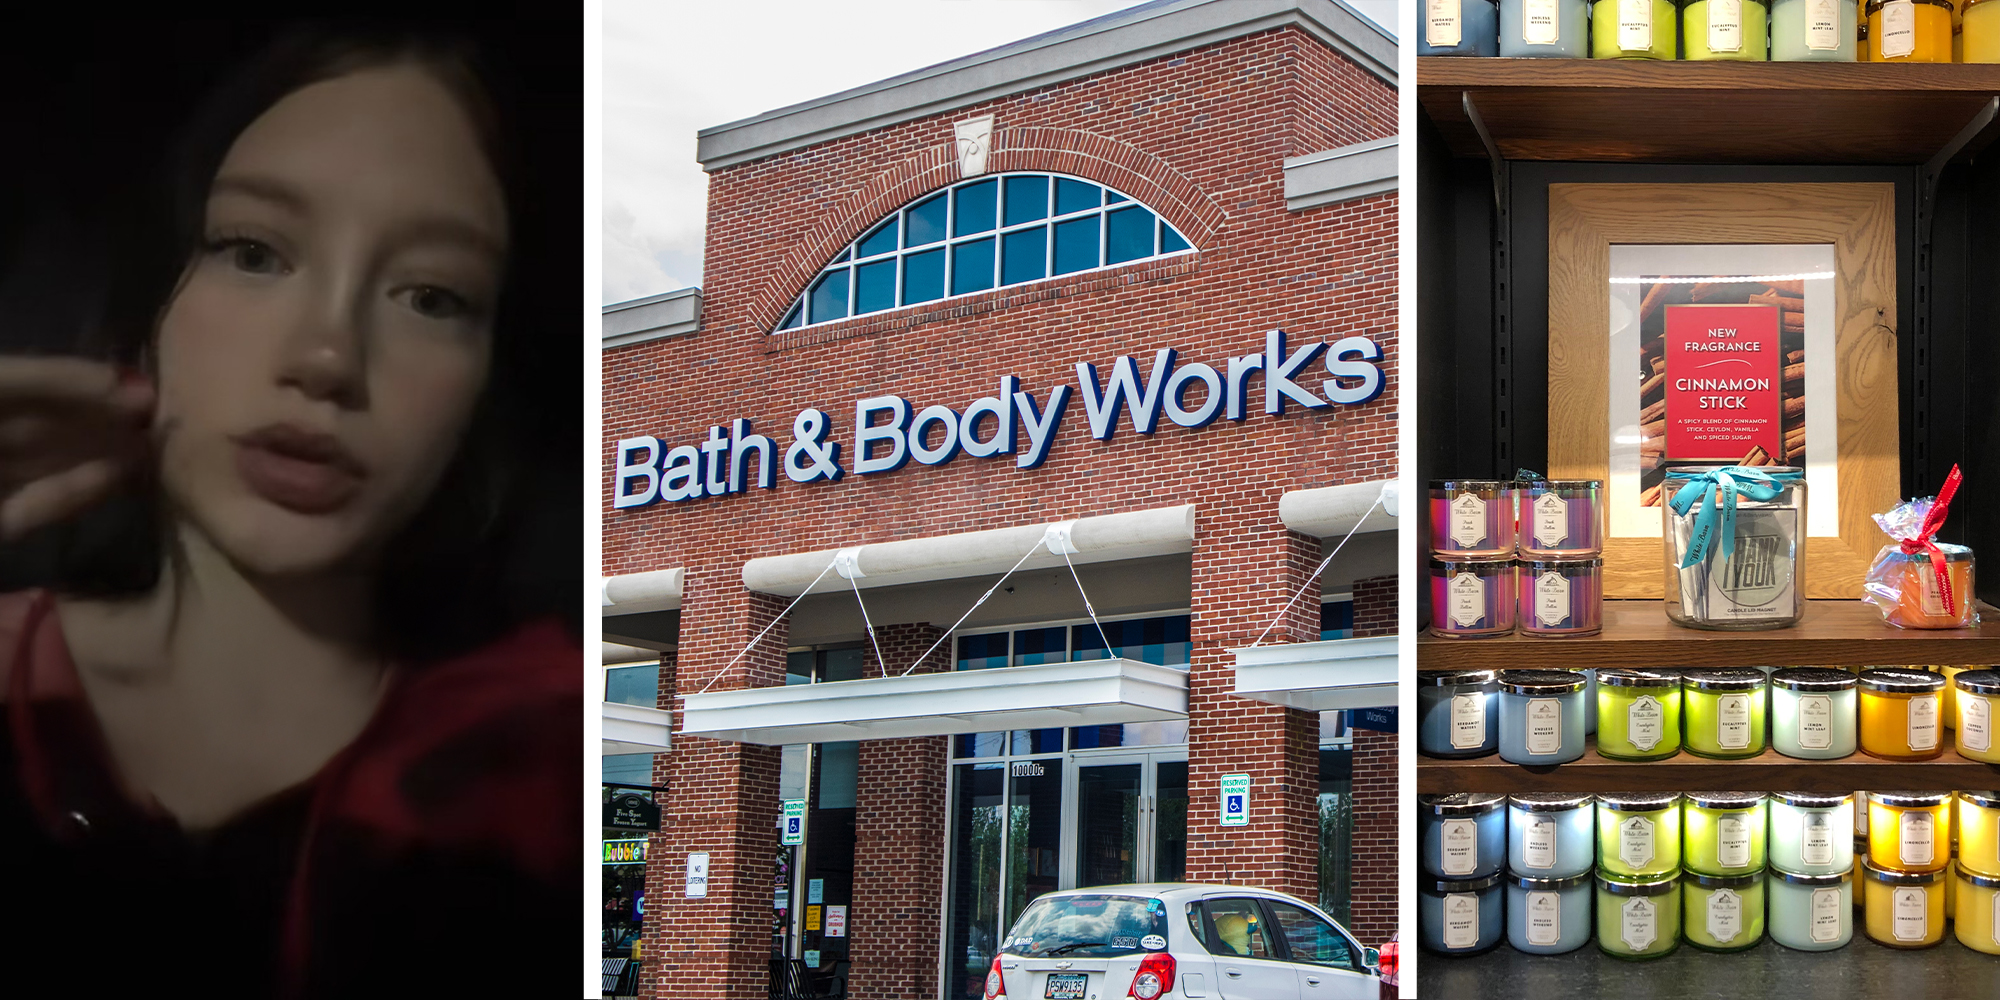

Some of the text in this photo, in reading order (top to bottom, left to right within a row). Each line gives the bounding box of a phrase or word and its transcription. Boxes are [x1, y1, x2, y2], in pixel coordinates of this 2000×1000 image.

[1884, 30, 1910, 38] LIMONCELLO
[1708, 328, 1738, 338] NEW
[1685, 341, 1761, 352] FRAGRANCE
[1675, 378, 1770, 391] CINNAMON
[1699, 396, 1747, 409] STICK
[614, 329, 1386, 509] Bath & Body Works
[1690, 525, 1710, 562] White Barn
[1734, 561, 1770, 589] YOU
[1366, 710, 1387, 724] Works
[616, 808, 641, 818] Five Spot
[613, 816, 647, 828] Frozen Yogurt
[604, 843, 640, 862] Bubble
[694, 865, 702, 873] NO
[688, 876, 706, 885] LOITERING
[1050, 980, 1082, 992] PSW9135
